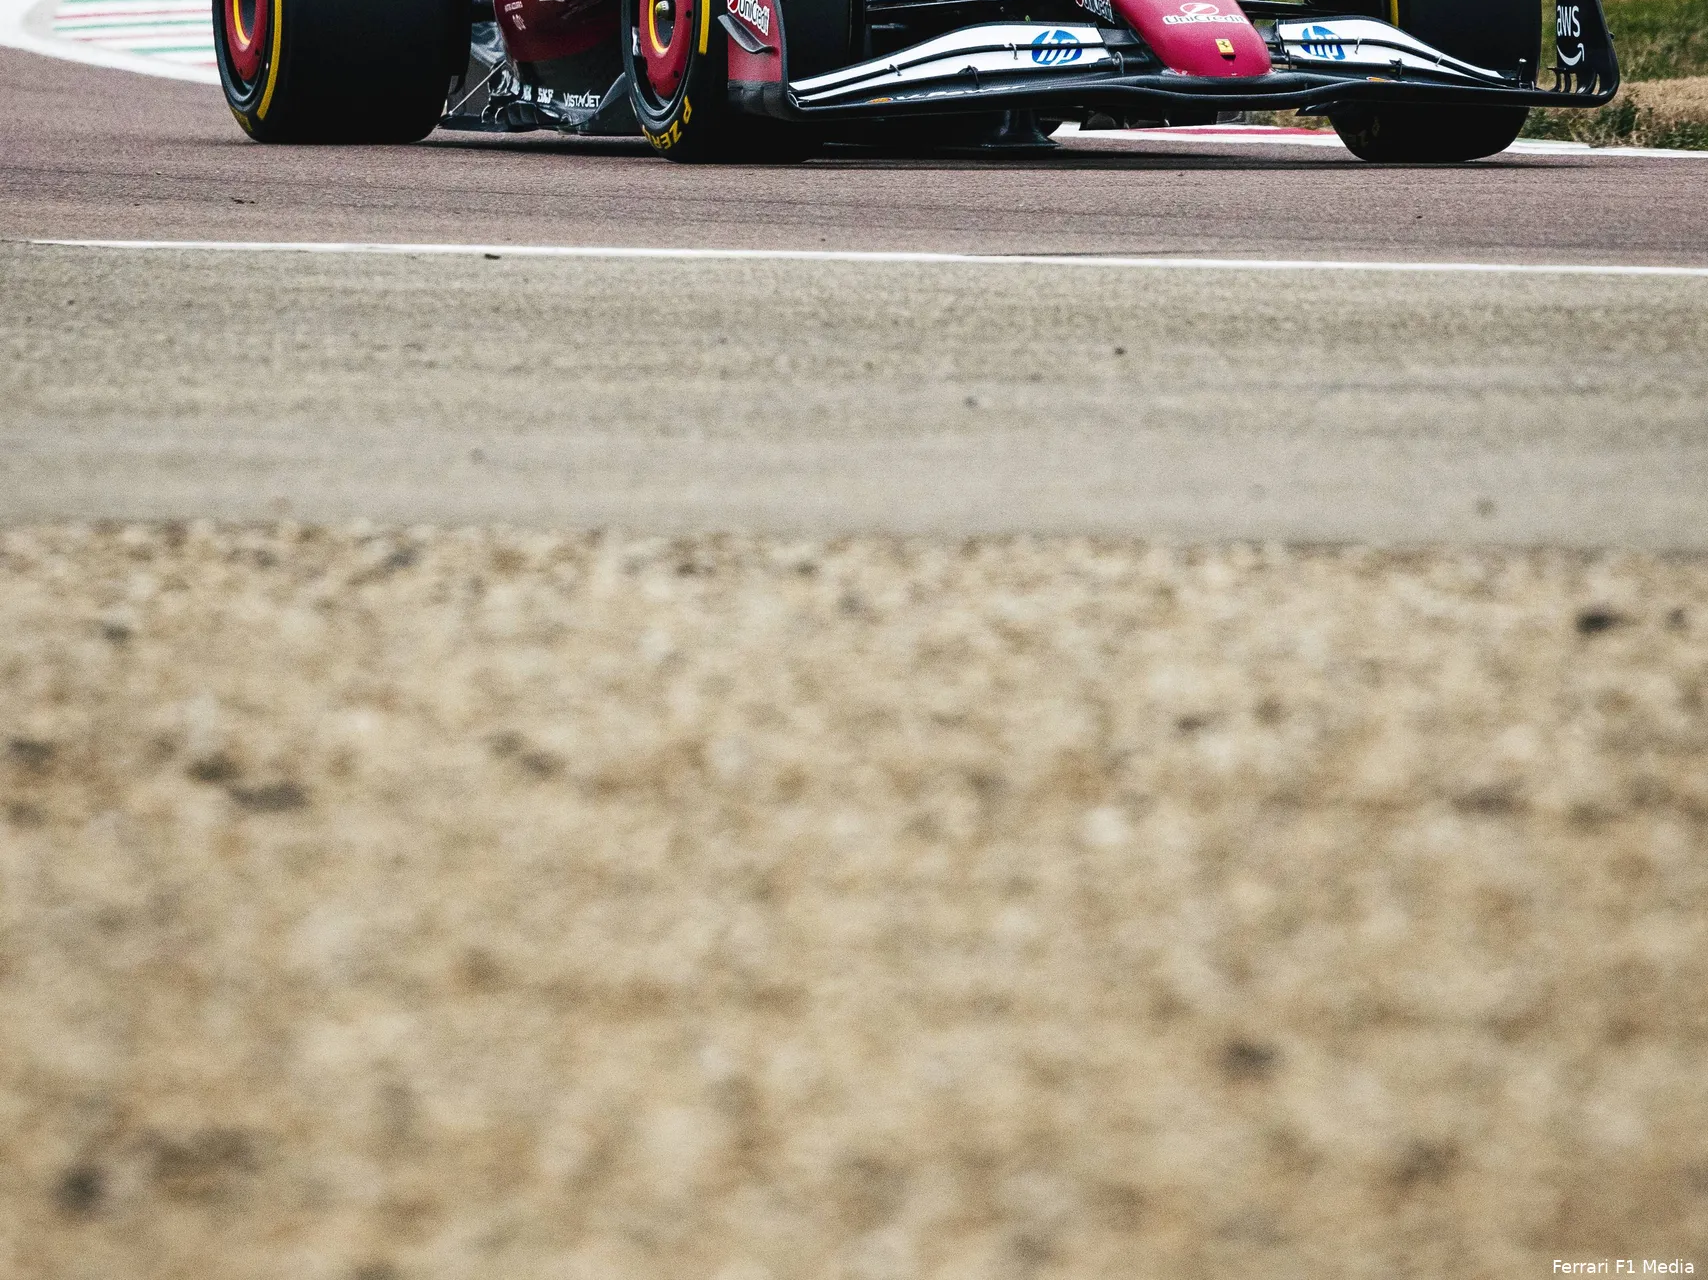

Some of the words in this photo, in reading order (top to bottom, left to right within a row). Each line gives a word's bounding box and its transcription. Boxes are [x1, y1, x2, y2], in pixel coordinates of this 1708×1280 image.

[1163, 13, 1250, 25] UniCredit
[1556, 5, 1580, 38] aws
[1037, 29, 1078, 65] hp
[1306, 25, 1341, 59] hp
[537, 87, 554, 103] SKF
